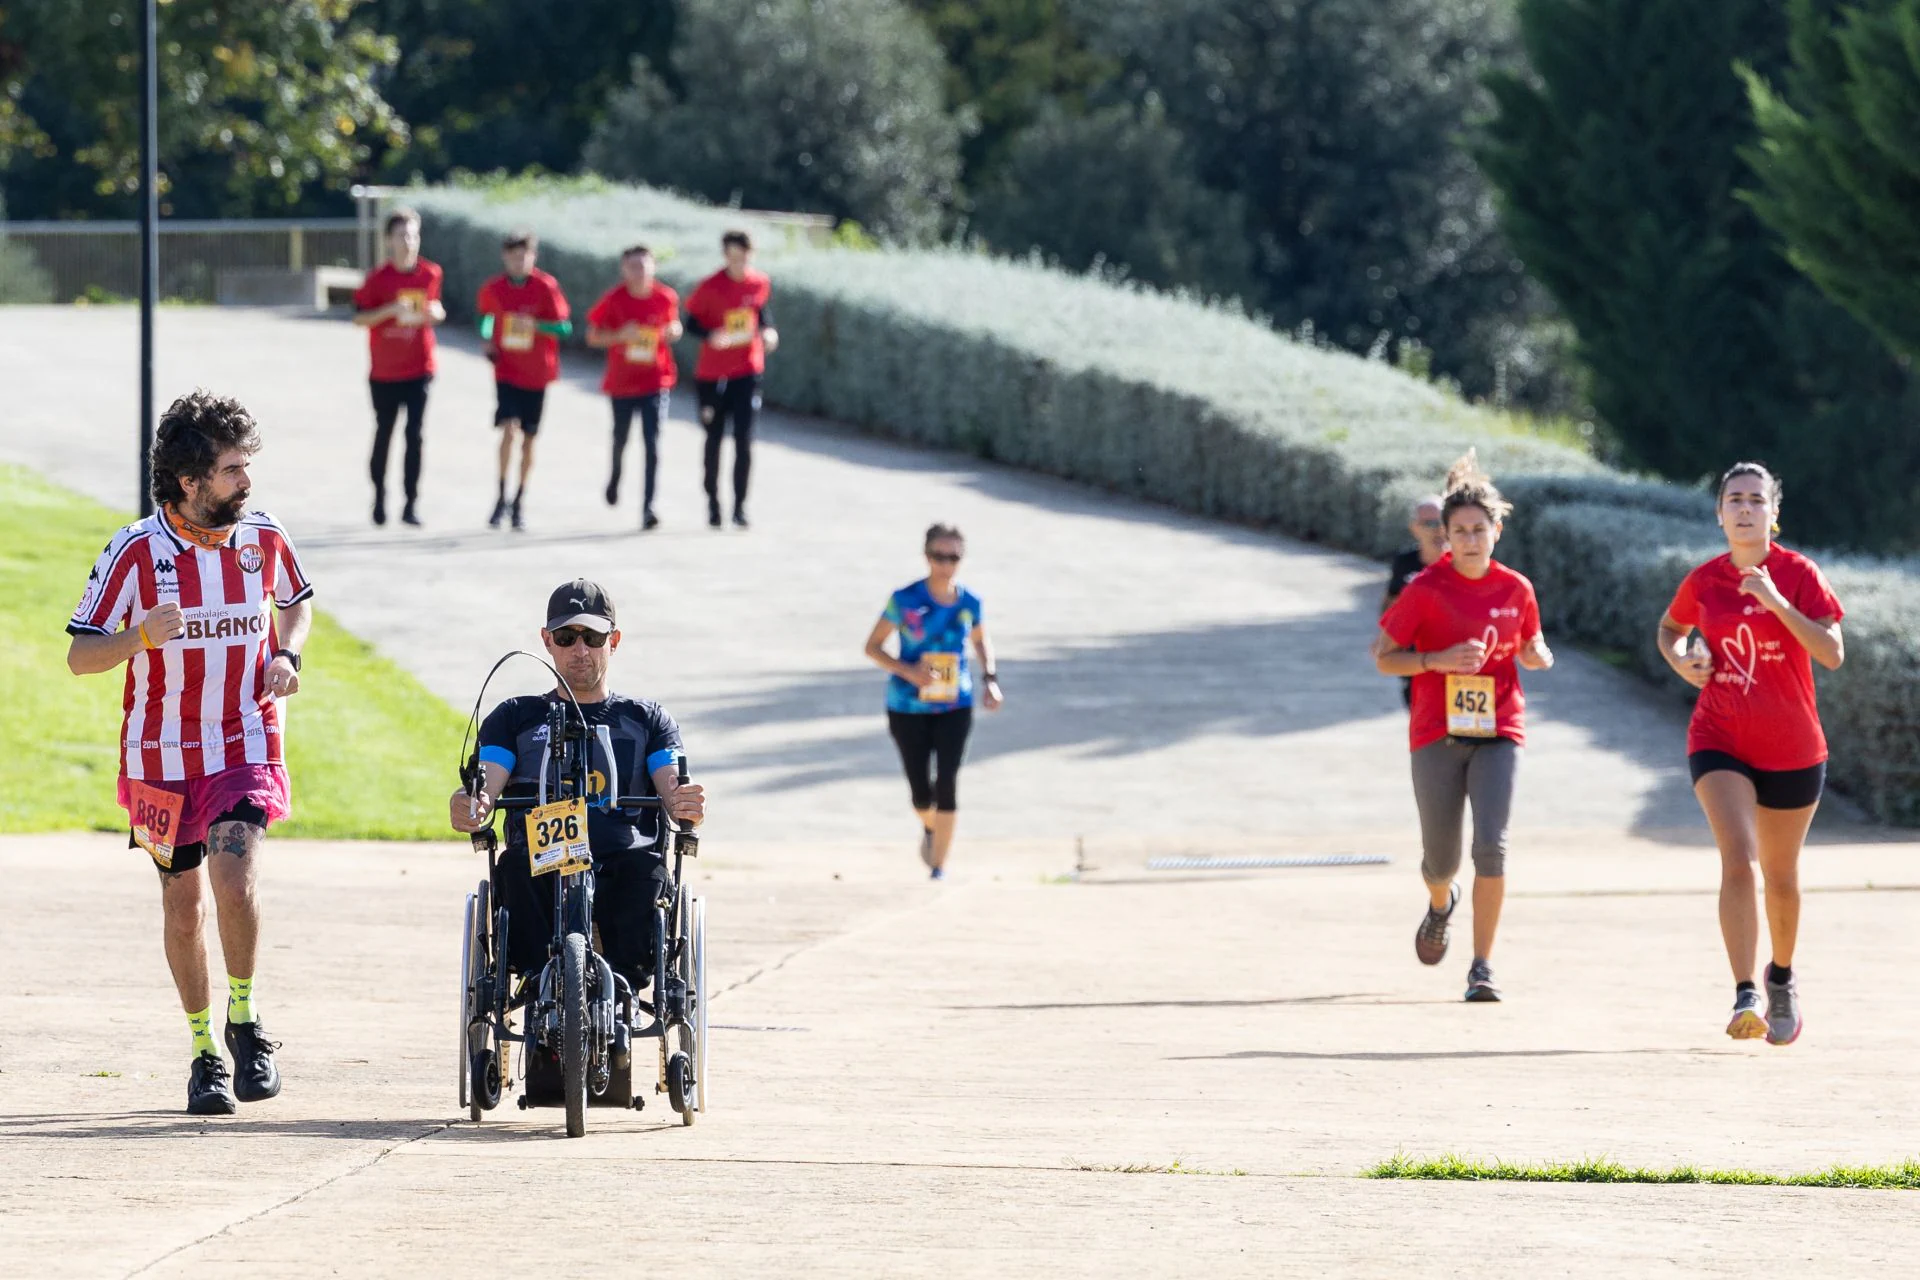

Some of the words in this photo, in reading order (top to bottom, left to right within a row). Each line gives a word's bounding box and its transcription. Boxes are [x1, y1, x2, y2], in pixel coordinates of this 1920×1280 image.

[185, 610, 229, 620] embalajes
[186, 613, 266, 640] BLANCO
[1454, 691, 1487, 713] 452
[142, 740, 159, 749] 2019
[225, 732, 243, 743] 2016
[247, 727, 262, 737] 2015
[137, 798, 171, 837] 889
[536, 814, 579, 848] 326
